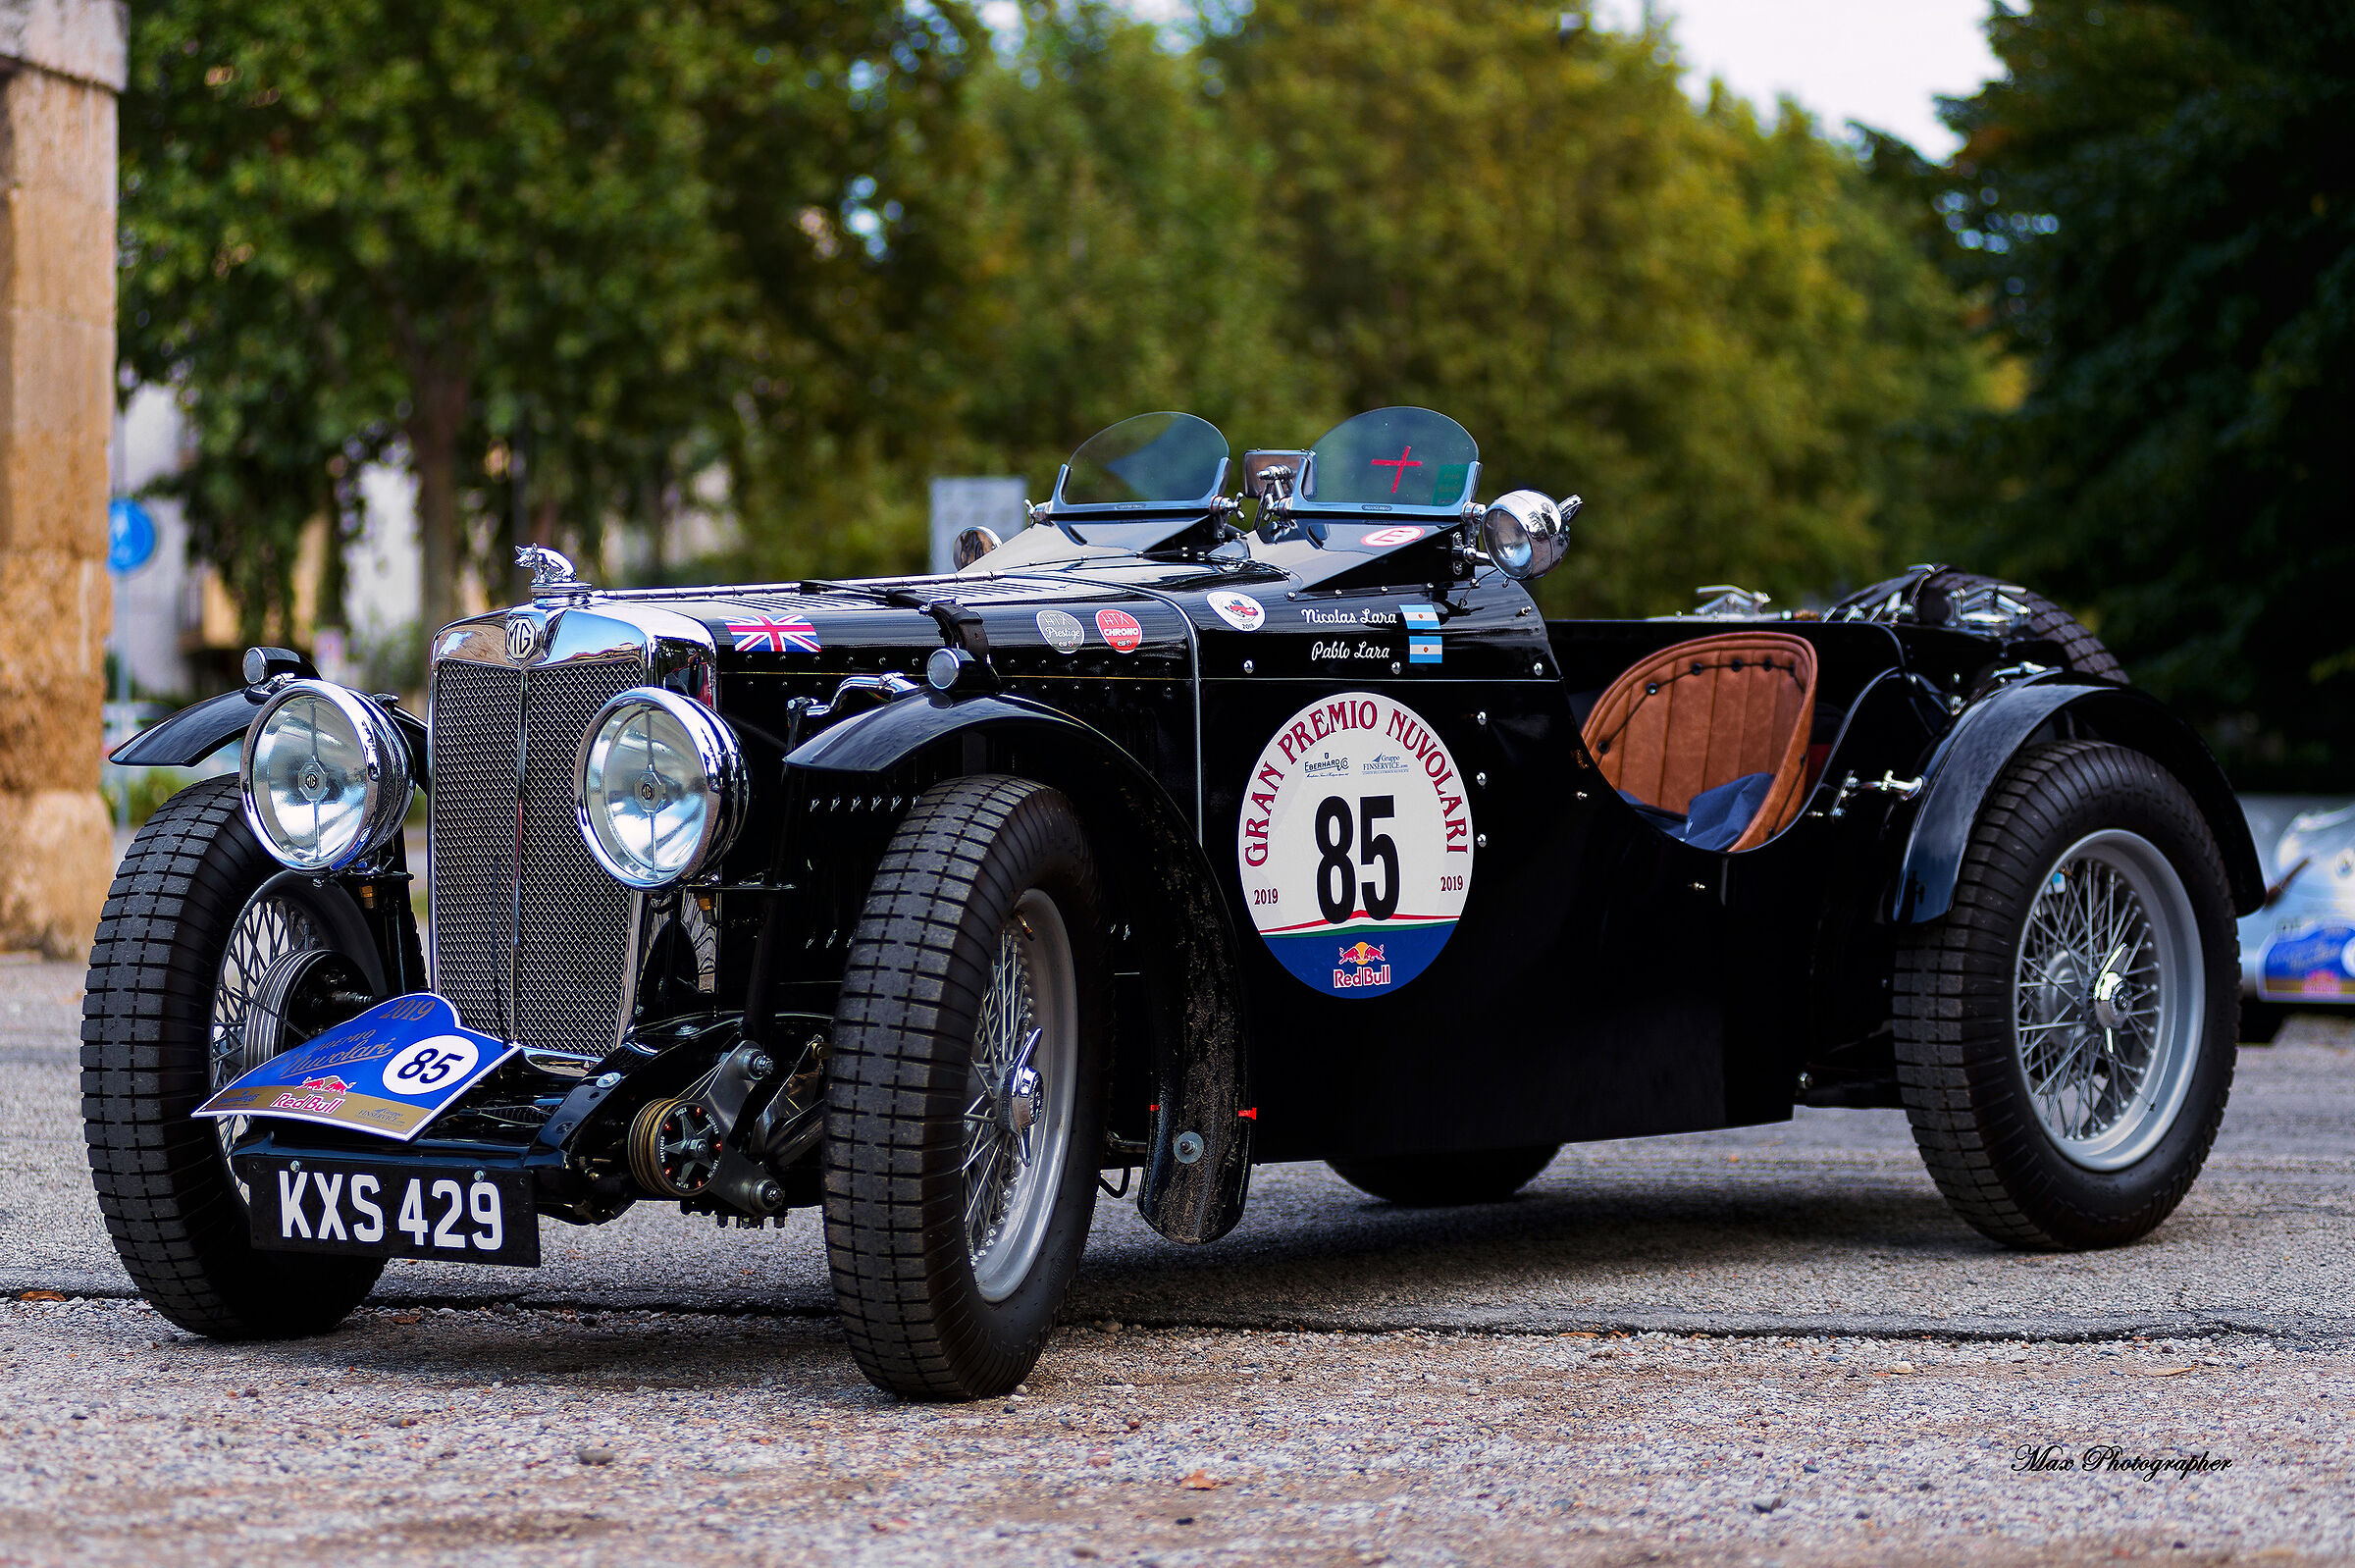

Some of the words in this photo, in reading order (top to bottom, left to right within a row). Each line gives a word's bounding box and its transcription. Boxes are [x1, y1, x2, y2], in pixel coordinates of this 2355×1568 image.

[1042, 613, 1072, 626] HTX
[1101, 613, 1130, 626] HTX
[1301, 608, 1357, 623] Nicolas
[1360, 607, 1397, 624] Lara
[507, 622, 531, 655] MG
[1045, 627, 1080, 640] Prestige
[1103, 628, 1139, 637] CHRONO
[1311, 641, 1350, 660] Pablo
[1354, 641, 1390, 659] Lara
[1244, 759, 1285, 867] GRAN
[1277, 700, 1378, 765] PREMIO
[1386, 707, 1469, 855] NUVOLARI
[1315, 795, 1400, 924] 85
[1440, 875, 1463, 892] 2019
[1253, 888, 1279, 906] 2019
[1334, 966, 1362, 988] Red
[1363, 965, 1390, 986] Bull
[378, 999, 436, 1020] 2019
[397, 1048, 465, 1084] 85
[271, 1093, 314, 1110] Red
[301, 1095, 345, 1115] Bull
[279, 1171, 384, 1242] KXS
[398, 1178, 502, 1250] 429
